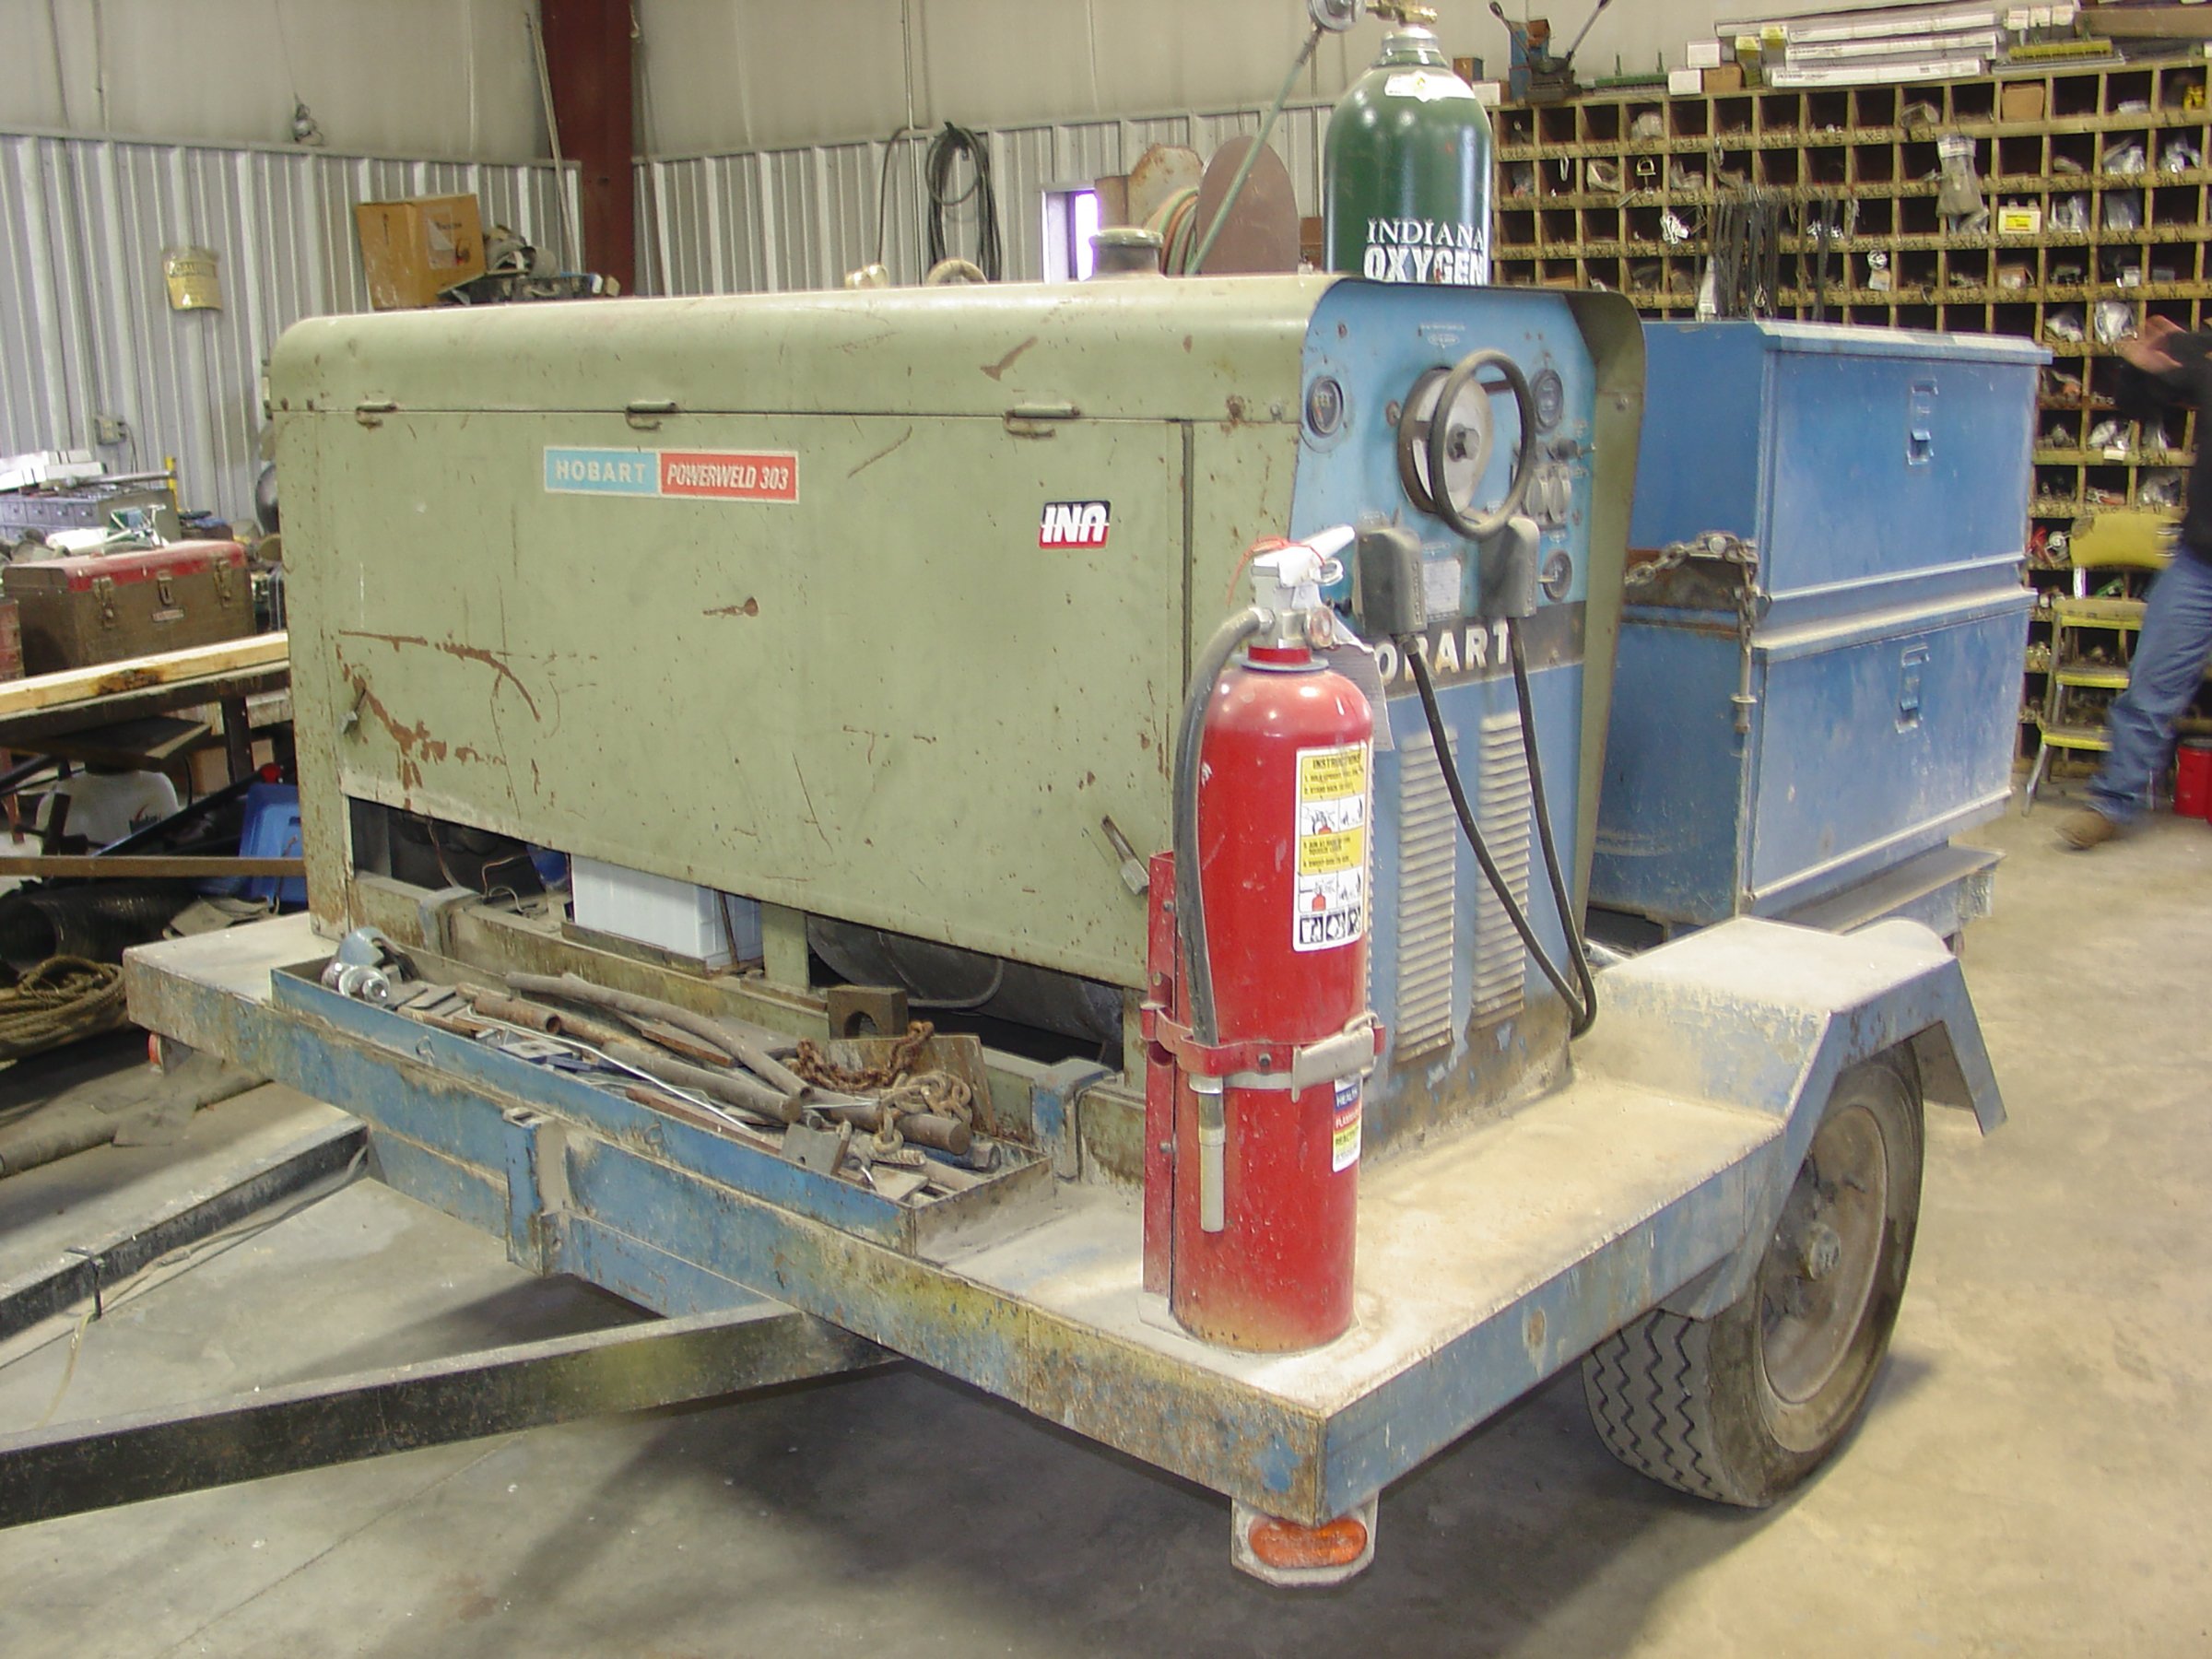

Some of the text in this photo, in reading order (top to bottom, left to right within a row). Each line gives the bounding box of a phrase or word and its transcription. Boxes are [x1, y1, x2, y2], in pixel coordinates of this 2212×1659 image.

[1367, 218, 1483, 250] INDIANA
[1364, 244, 1487, 286] OXYGEN
[555, 460, 645, 484] HOBART
[666, 464, 789, 490] POWERWELD 303
[1041, 503, 1106, 543] INA
